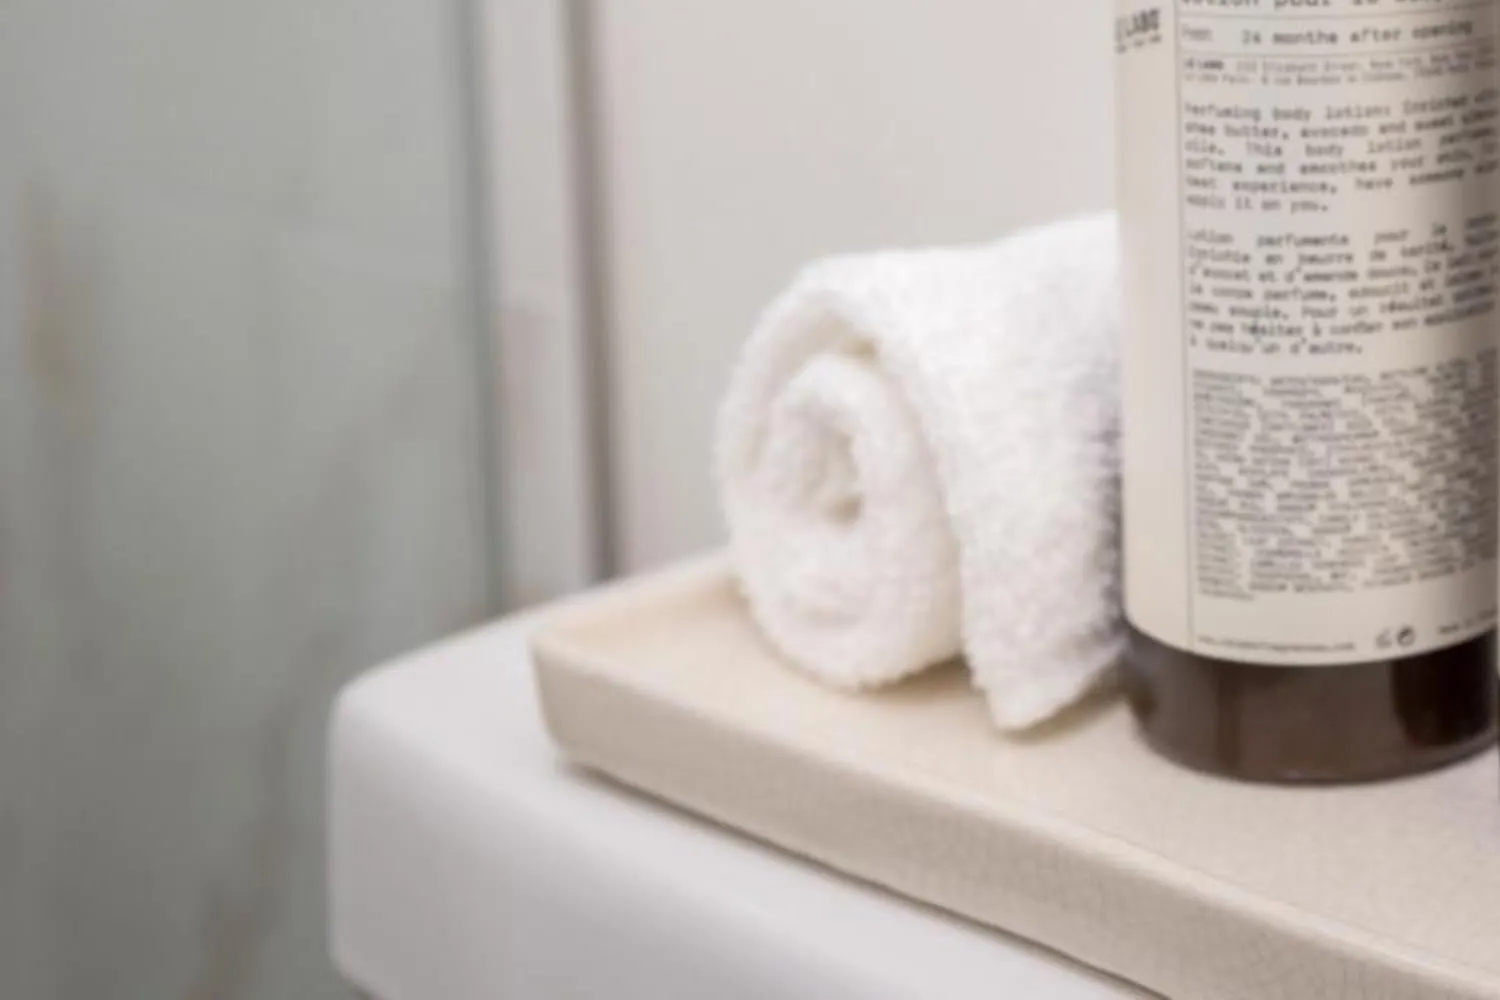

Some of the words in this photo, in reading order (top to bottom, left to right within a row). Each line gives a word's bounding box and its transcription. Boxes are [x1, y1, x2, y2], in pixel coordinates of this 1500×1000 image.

[1272, 29, 1338, 46] months
[1349, 26, 1401, 44] after
[1412, 20, 1473, 42] opening
